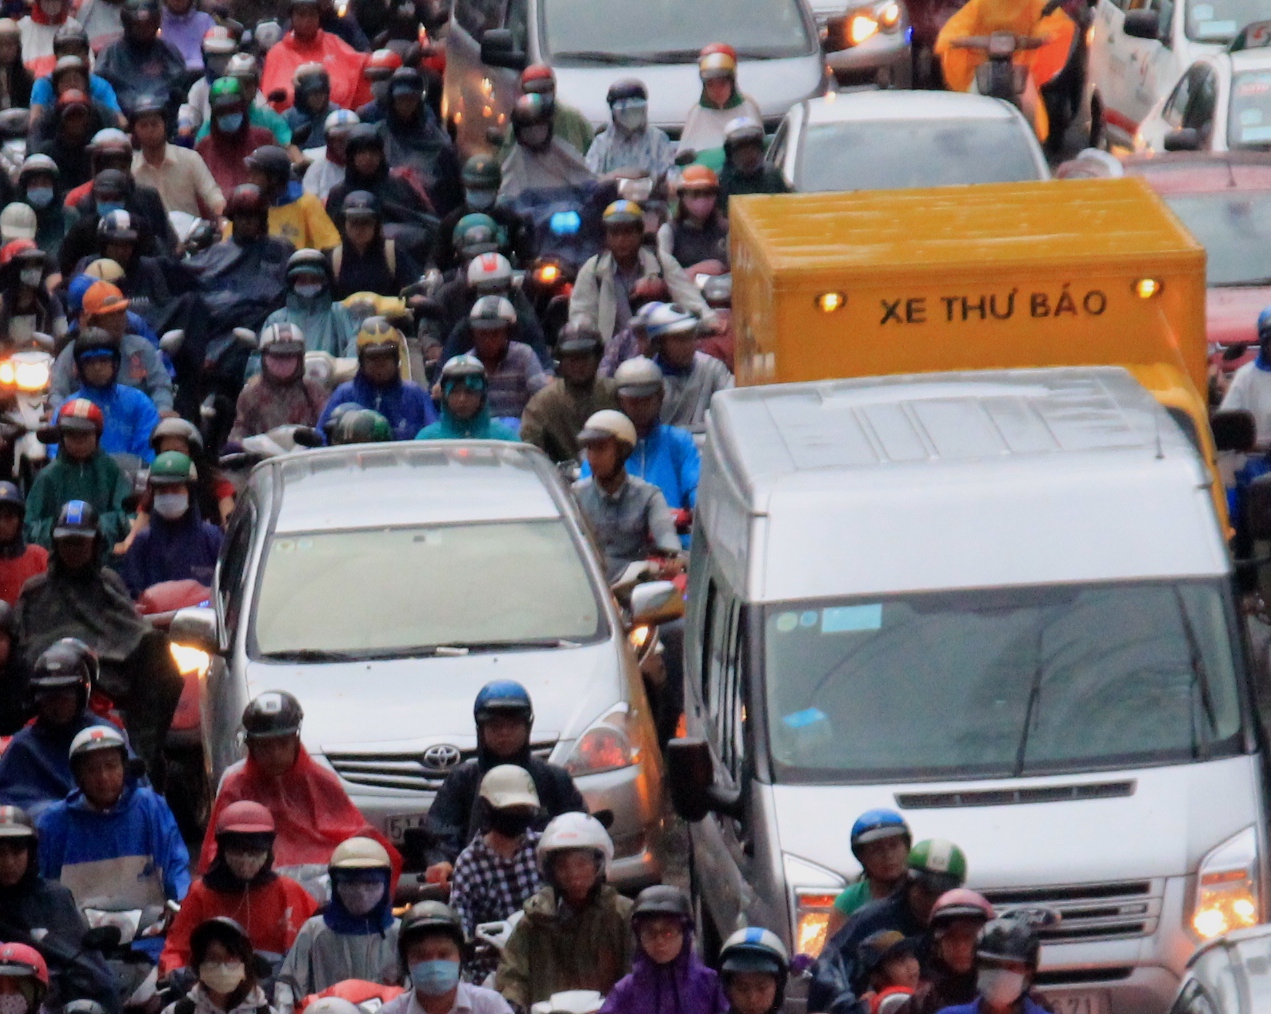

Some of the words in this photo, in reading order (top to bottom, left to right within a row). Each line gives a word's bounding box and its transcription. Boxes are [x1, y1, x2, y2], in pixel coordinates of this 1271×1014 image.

[879, 296, 928, 325] XE
[940, 286, 1019, 322] THƯ
[1030, 281, 1108, 319] BÁO
